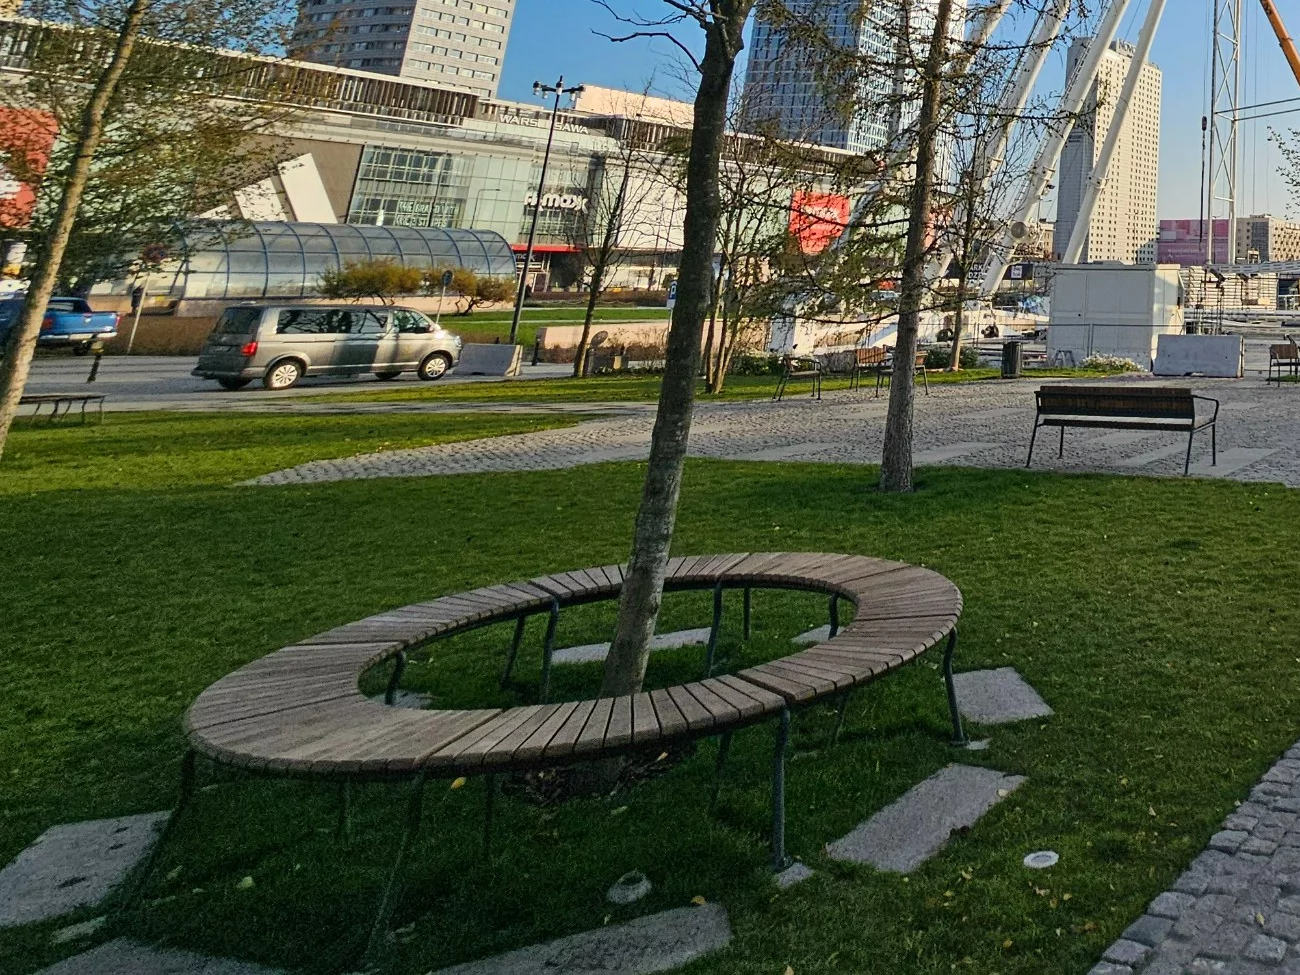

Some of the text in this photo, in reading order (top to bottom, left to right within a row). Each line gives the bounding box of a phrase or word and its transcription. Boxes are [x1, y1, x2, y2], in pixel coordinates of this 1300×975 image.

[500, 113, 589, 135] WARS SAWA
[414, 203, 441, 214] BRAD
[418, 218, 449, 228] STIPES
[670, 285, 677, 298] P
